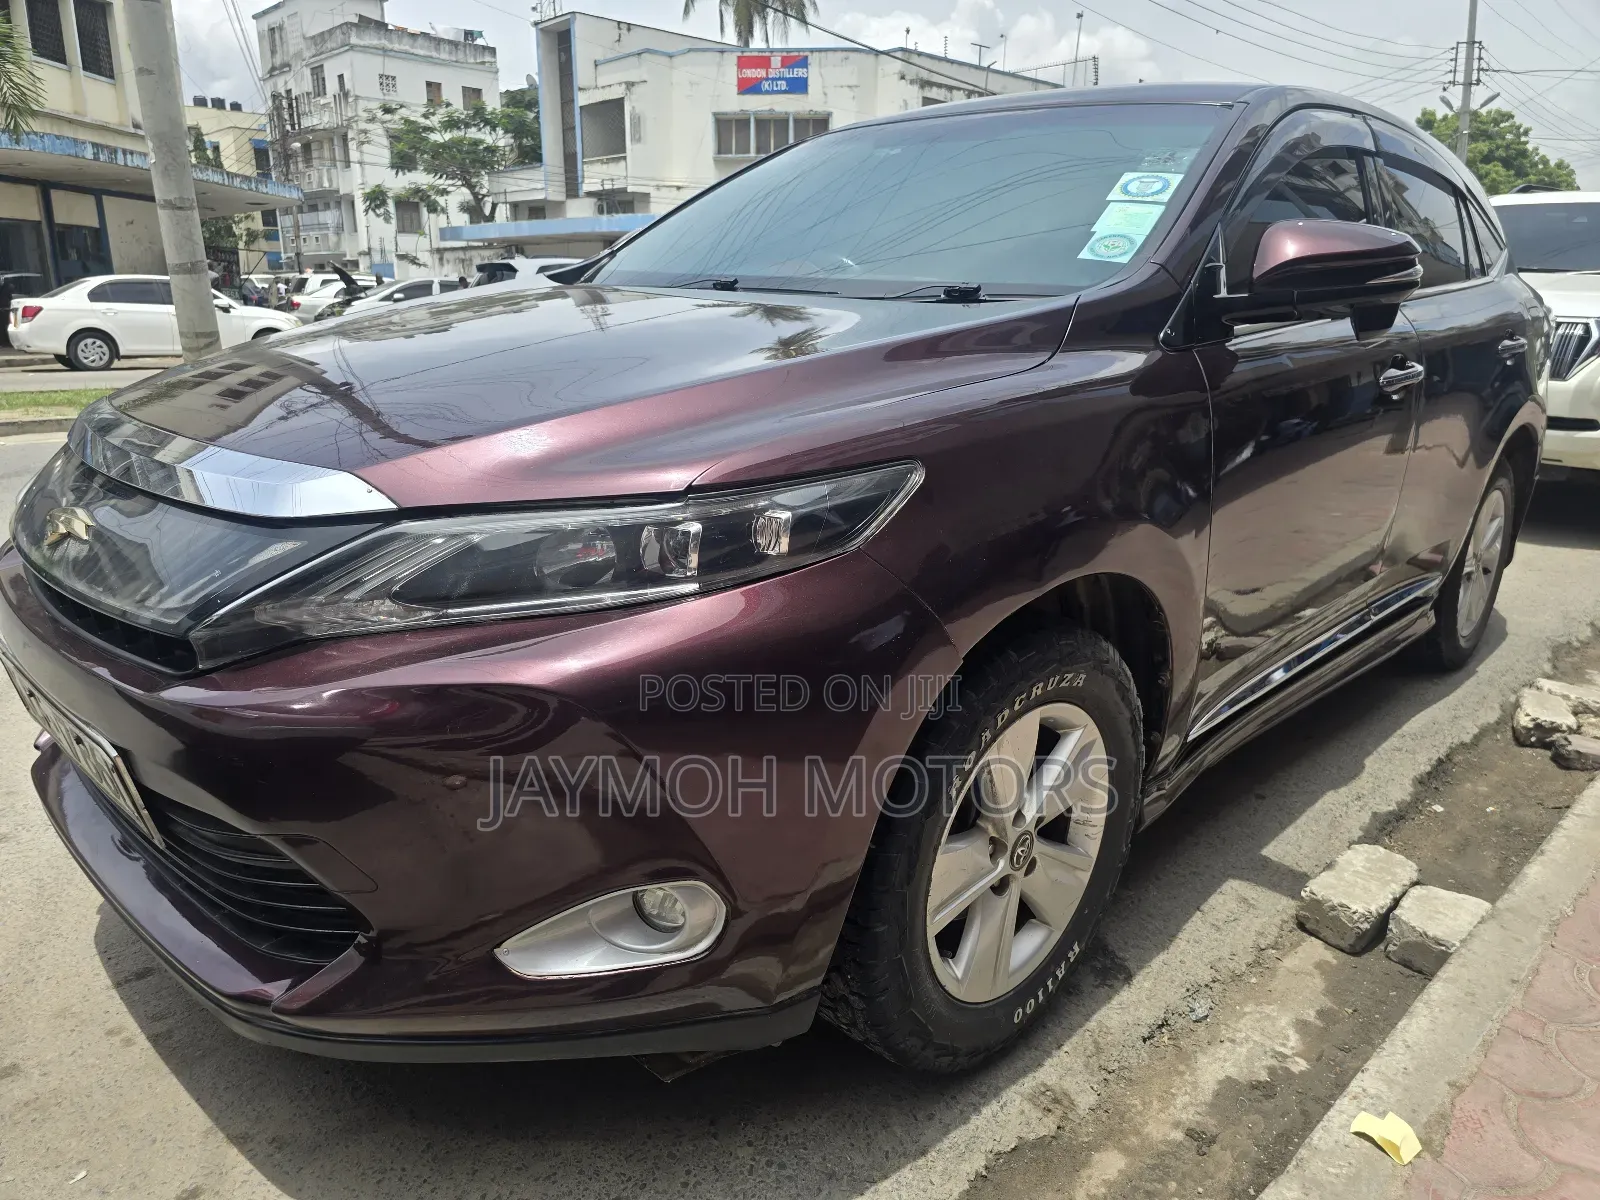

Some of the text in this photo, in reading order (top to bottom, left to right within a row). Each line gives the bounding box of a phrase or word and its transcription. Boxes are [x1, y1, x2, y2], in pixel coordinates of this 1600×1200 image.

[738, 68, 808, 79] LONDON DISTILLERS
[761, 80, 773, 92] (K)
[1013, 940, 1081, 1025] RA1100
